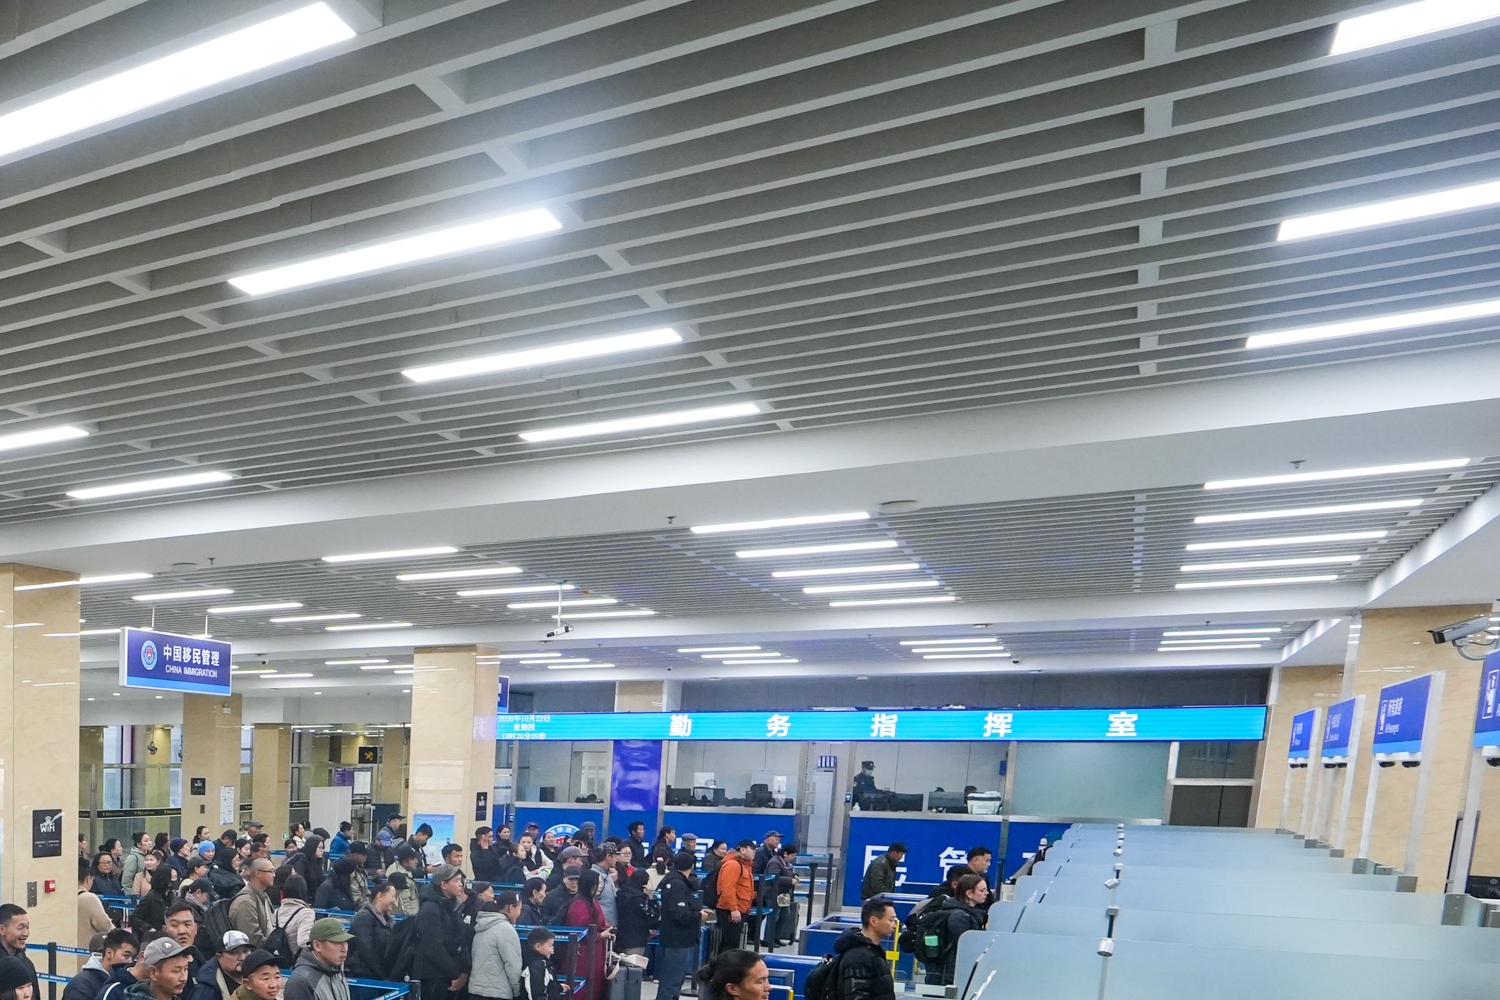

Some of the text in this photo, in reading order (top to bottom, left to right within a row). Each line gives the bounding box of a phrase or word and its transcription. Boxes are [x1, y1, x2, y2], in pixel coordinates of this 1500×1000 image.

[163, 644, 220, 667] 中国移民管理
[165, 664, 218, 678] CHINA IMMIGRATION
[668, 711, 1140, 740] 勤务指挥室
[40, 822, 55, 833] WiFi
